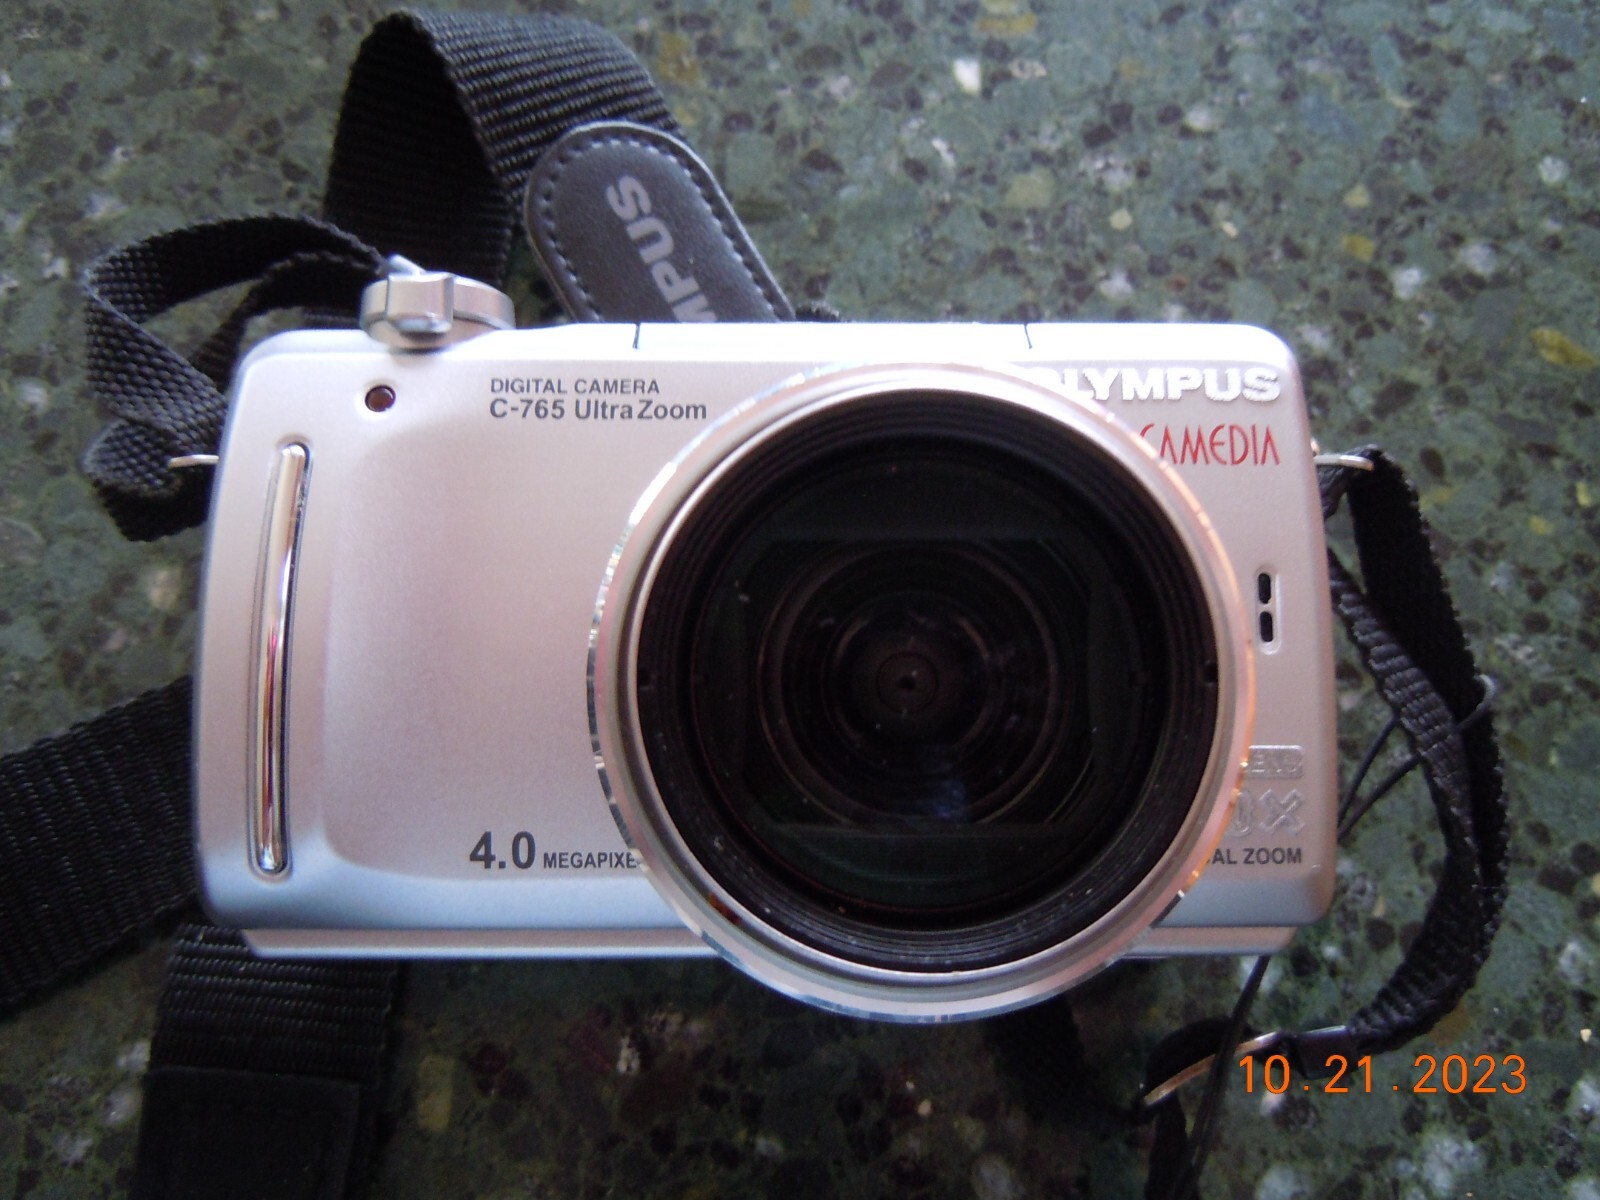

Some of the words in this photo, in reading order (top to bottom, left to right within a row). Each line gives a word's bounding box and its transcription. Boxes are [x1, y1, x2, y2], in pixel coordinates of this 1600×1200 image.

[490, 378, 568, 394] DIGITAL
[574, 378, 660, 394] CAMERA
[489, 398, 565, 420] C-765
[469, 831, 536, 869] 4.0
[543, 852, 639, 868] MEGAPIXE
[1243, 848, 1302, 864] ZOOM
